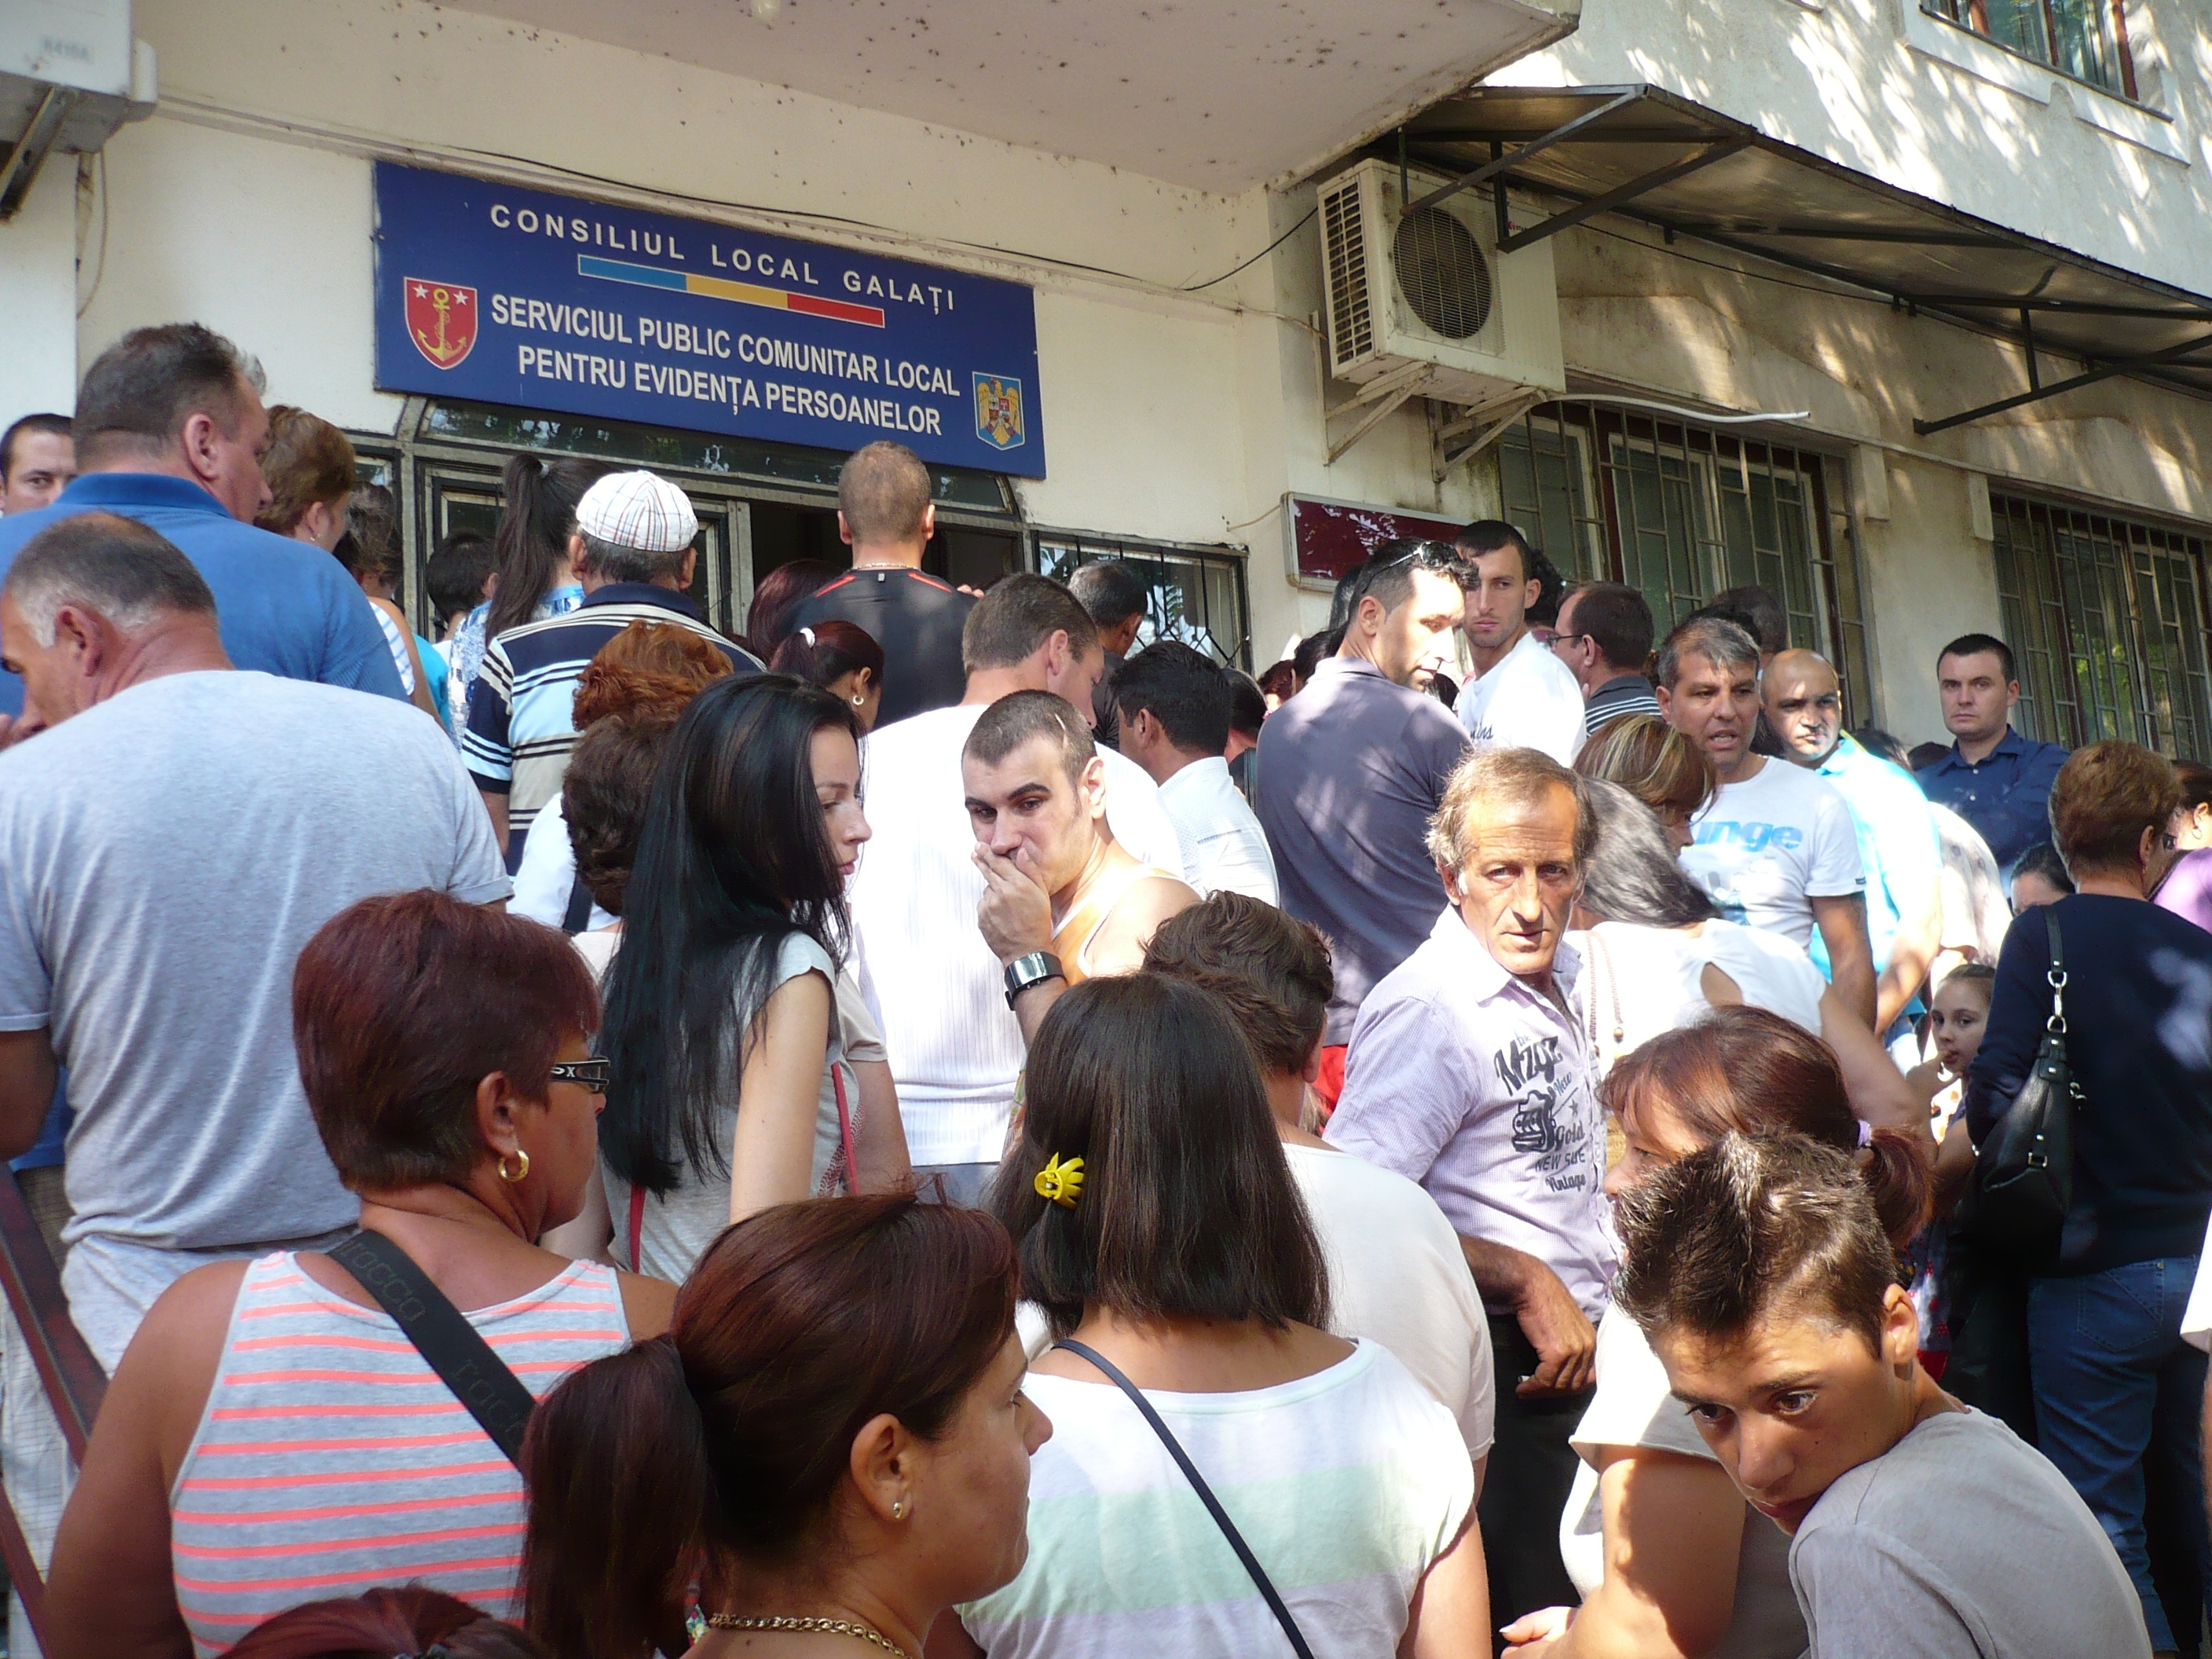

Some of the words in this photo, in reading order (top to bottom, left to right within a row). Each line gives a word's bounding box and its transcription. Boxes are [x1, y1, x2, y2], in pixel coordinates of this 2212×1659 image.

[490, 204, 685, 260] CONSILIUL
[712, 244, 819, 285] LOCAL
[843, 270, 954, 315] GALAȚI
[491, 294, 633, 344] SERVICIUL
[639, 317, 731, 359] PUBLIC
[738, 334, 879, 383] COMUNITAR
[884, 358, 961, 397] LOCAL
[518, 345, 626, 389] PENTRU
[634, 361, 760, 416] EVIDENȚA
[765, 382, 942, 436] PERSOANELOR
[1535, 1153, 1562, 1172] NEW
